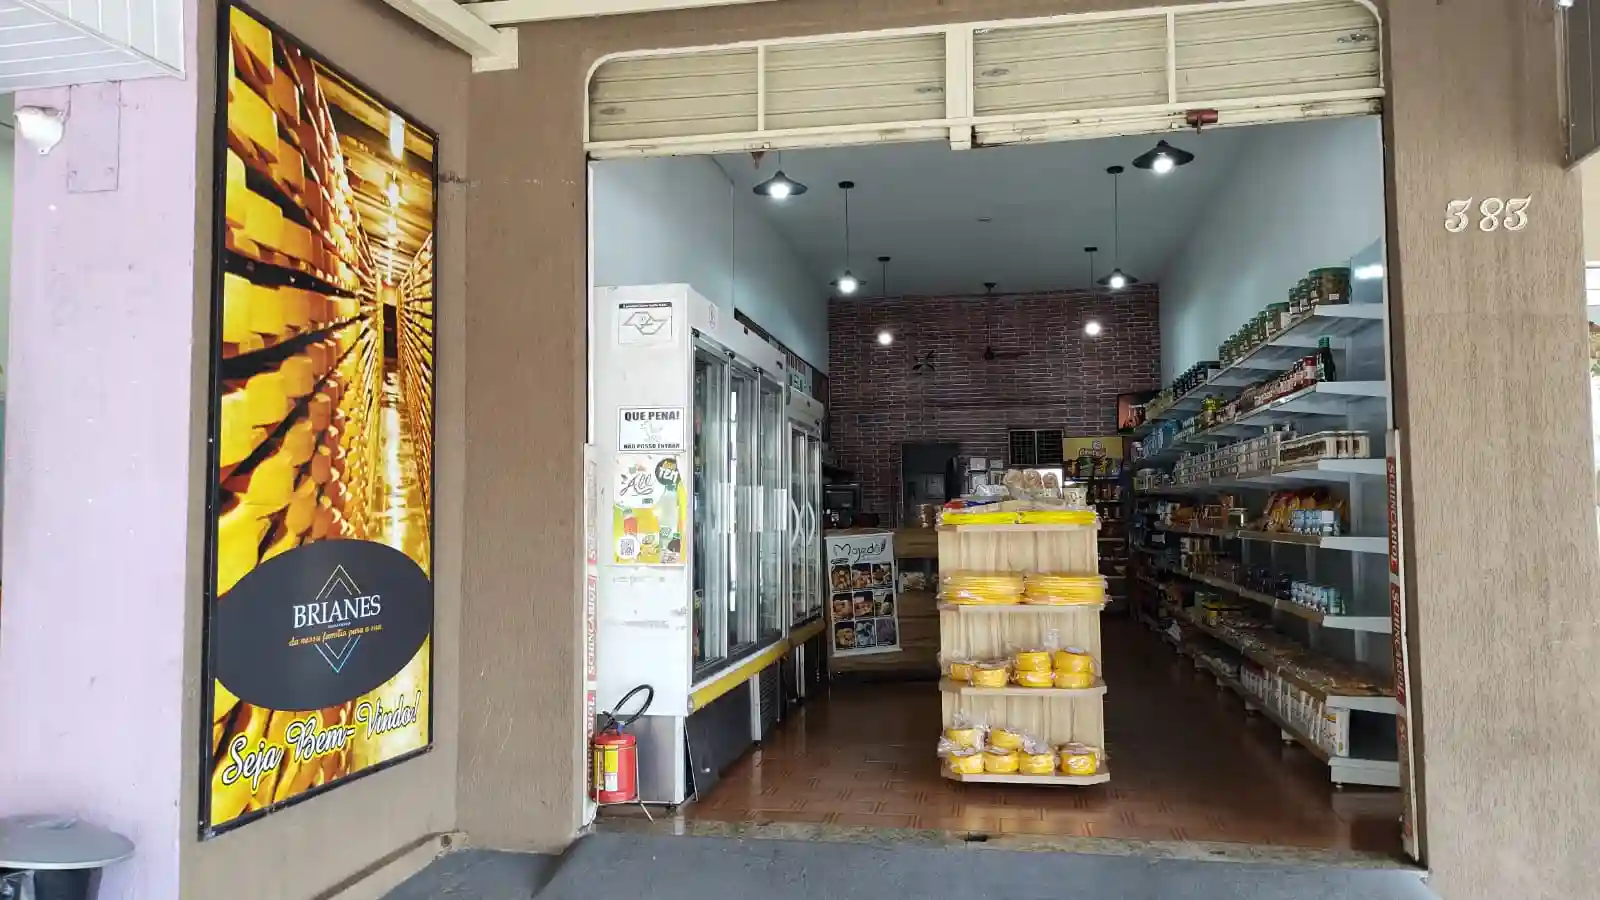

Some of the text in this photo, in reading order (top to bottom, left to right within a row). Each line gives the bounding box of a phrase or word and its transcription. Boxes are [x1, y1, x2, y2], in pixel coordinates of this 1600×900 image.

[1444, 192, 1533, 233] 383
[624, 410, 680, 422] QUE PENA!
[1387, 462, 1398, 566] SCHINCARIOL
[293, 594, 382, 629] BRIANES
[588, 582, 596, 676] SCHINCARIOL
[1392, 589, 1405, 697] SCHINCARIOL
[222, 690, 421, 790] Seja Bem- Vindo!
